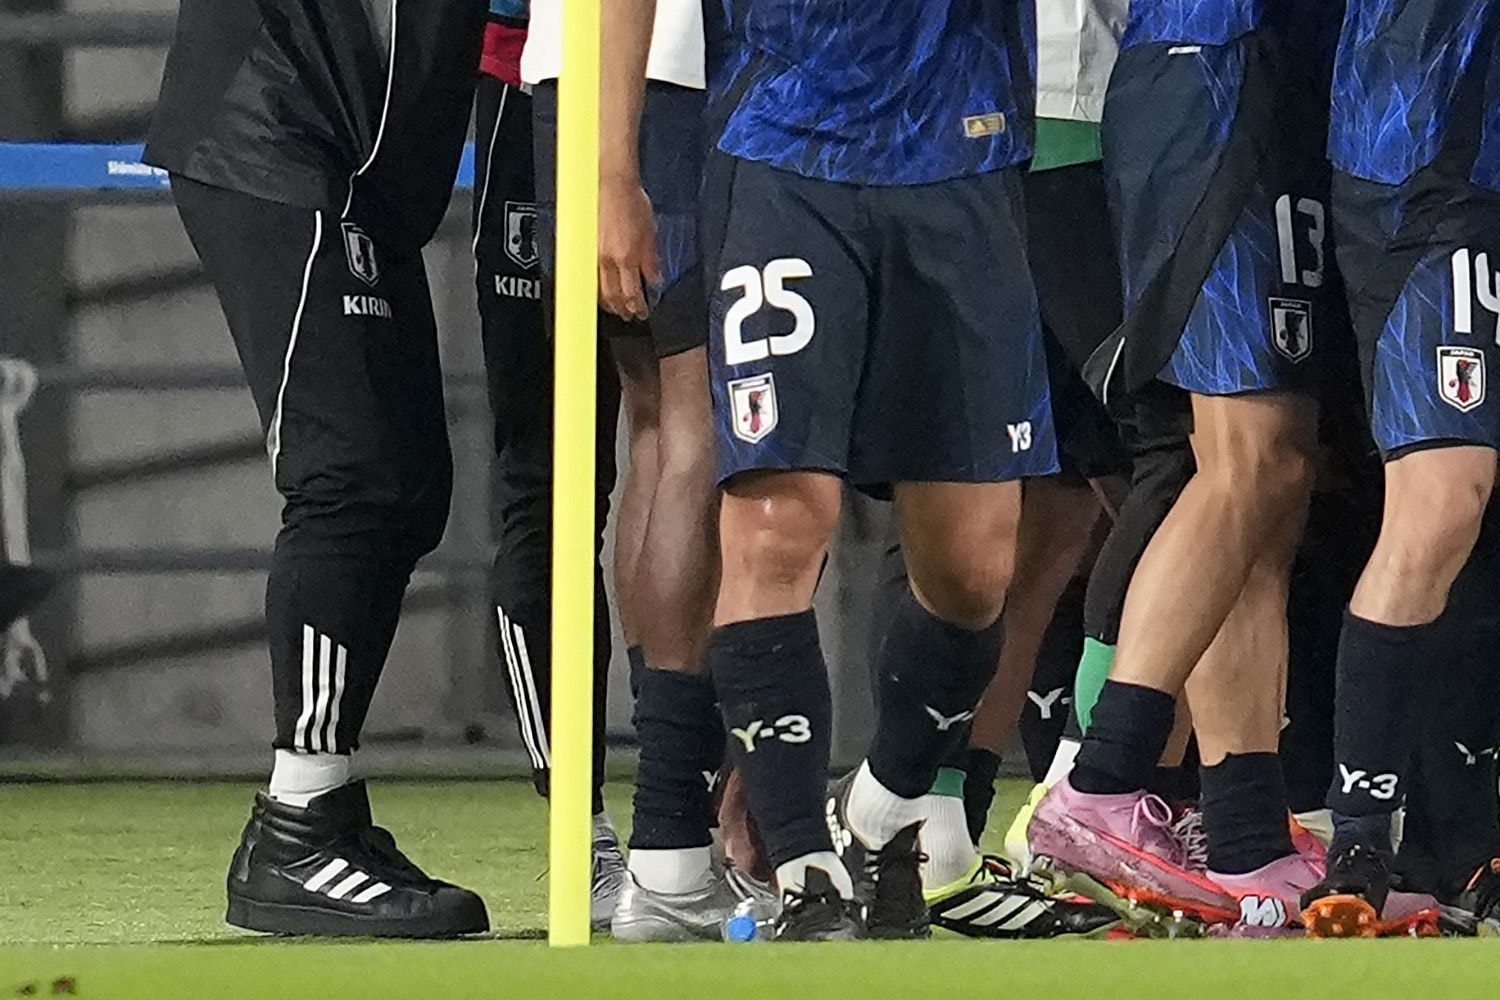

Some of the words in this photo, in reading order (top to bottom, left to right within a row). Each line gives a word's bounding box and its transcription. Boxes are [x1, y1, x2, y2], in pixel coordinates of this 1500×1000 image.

[1275, 194, 1326, 288] 13
[495, 275, 541, 299] KIRI
[721, 258, 816, 366] 25
[731, 714, 812, 753] Y-3
[1339, 763, 1399, 800] Y-3
